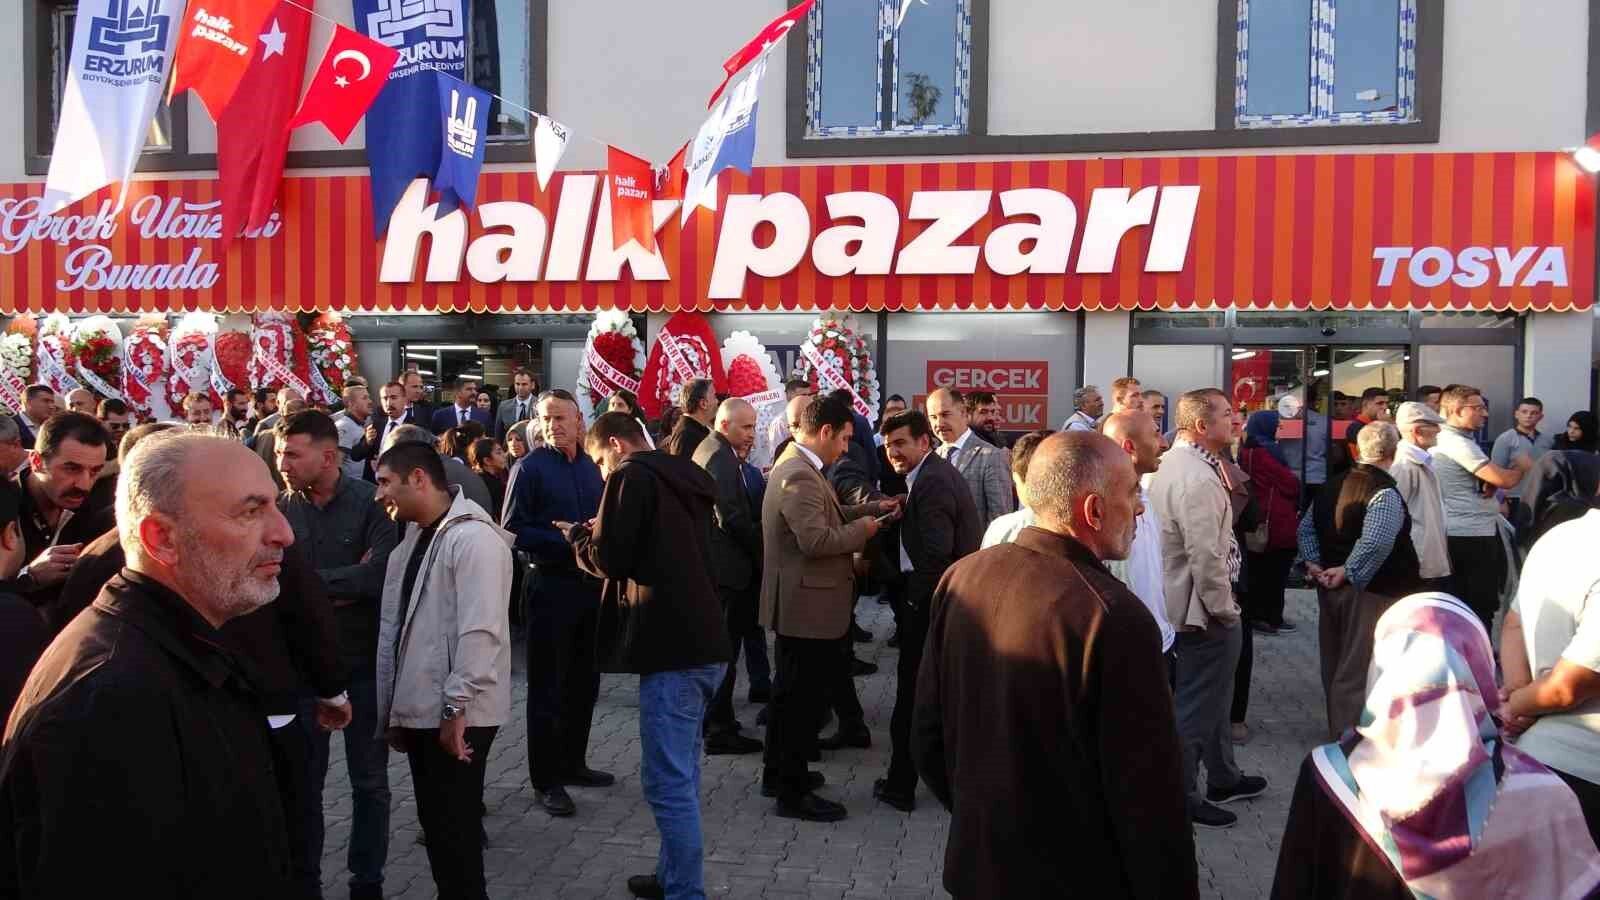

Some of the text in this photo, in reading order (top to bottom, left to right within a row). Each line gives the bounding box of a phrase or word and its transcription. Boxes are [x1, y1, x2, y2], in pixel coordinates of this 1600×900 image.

[84, 54, 164, 76] ERZURUM
[393, 39, 464, 68] ZURUM
[614, 174, 637, 188] halk
[0, 196, 118, 256] Gerçek
[379, 174, 1201, 299] halk pazarı
[57, 244, 219, 291] Burada
[1373, 246, 1569, 288] TOSYA
[933, 367, 1042, 391] GERÇEK
